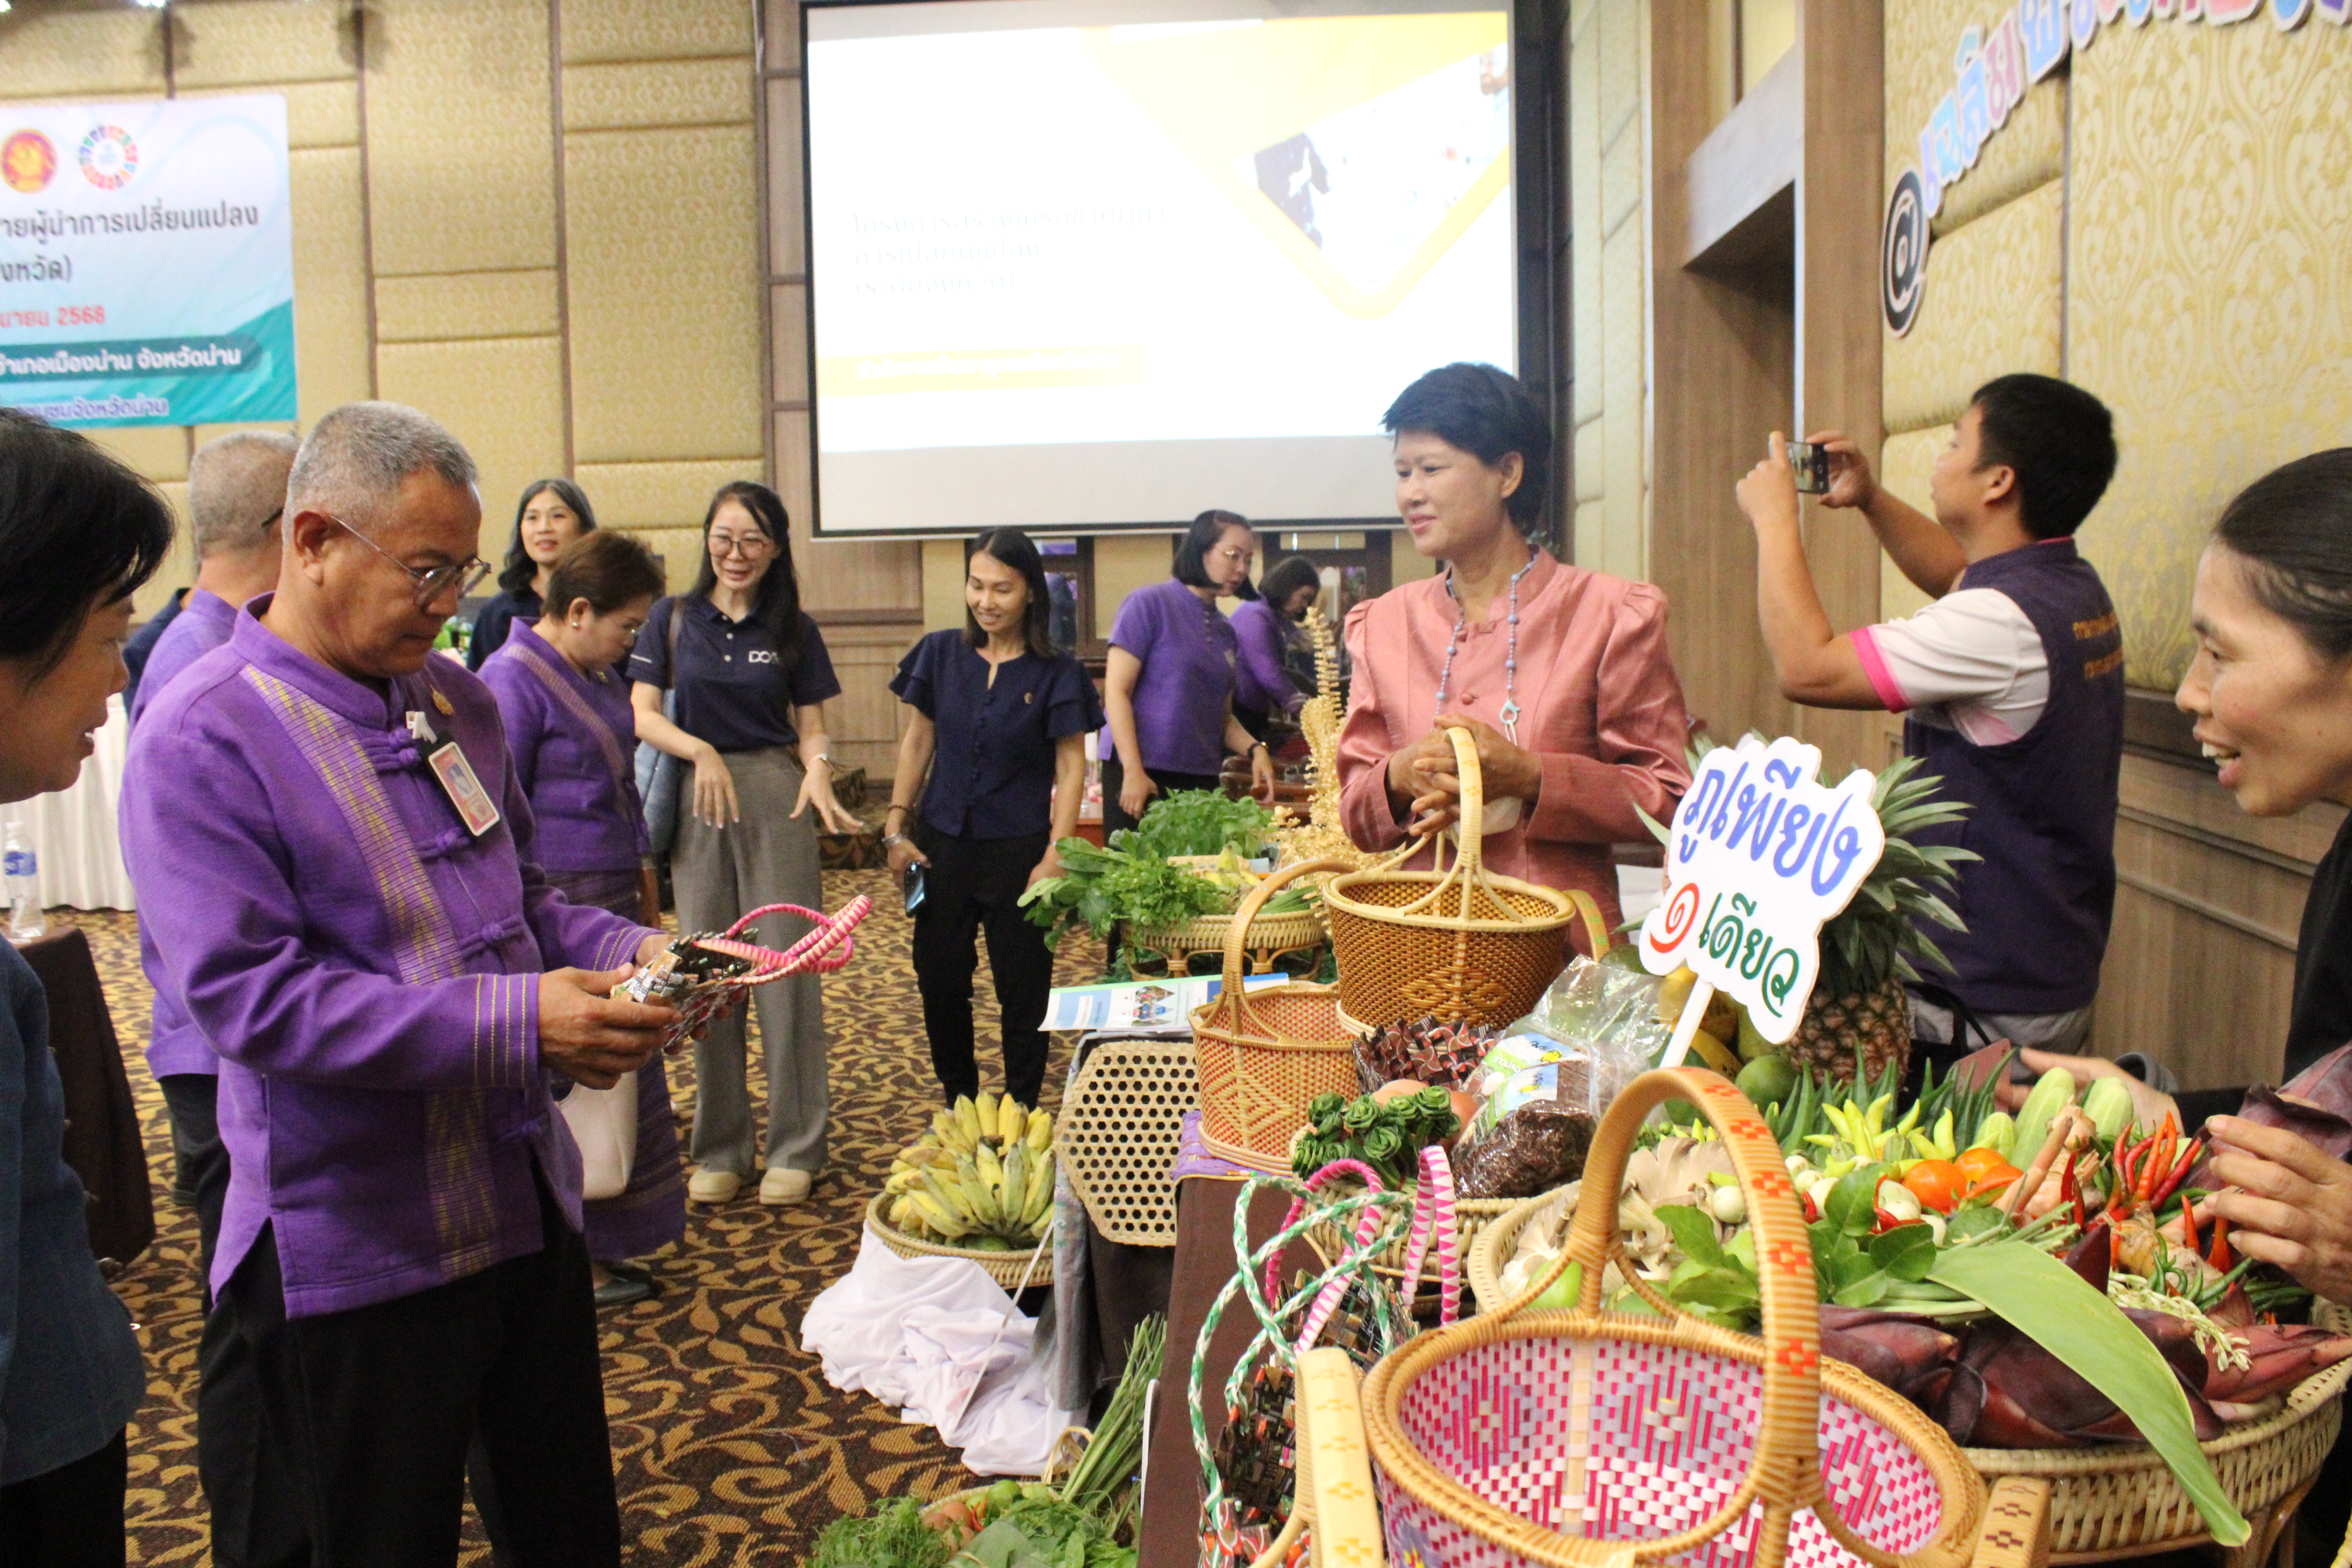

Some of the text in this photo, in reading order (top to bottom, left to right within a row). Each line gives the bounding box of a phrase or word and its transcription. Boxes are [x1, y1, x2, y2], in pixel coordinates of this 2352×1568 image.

[57, 305, 105, 325] 2568
[136, 343, 241, 370] จังหวัดน่าน
[1680, 759, 1863, 896] ภูเพียง
[1698, 892, 1799, 1018] เดียว
